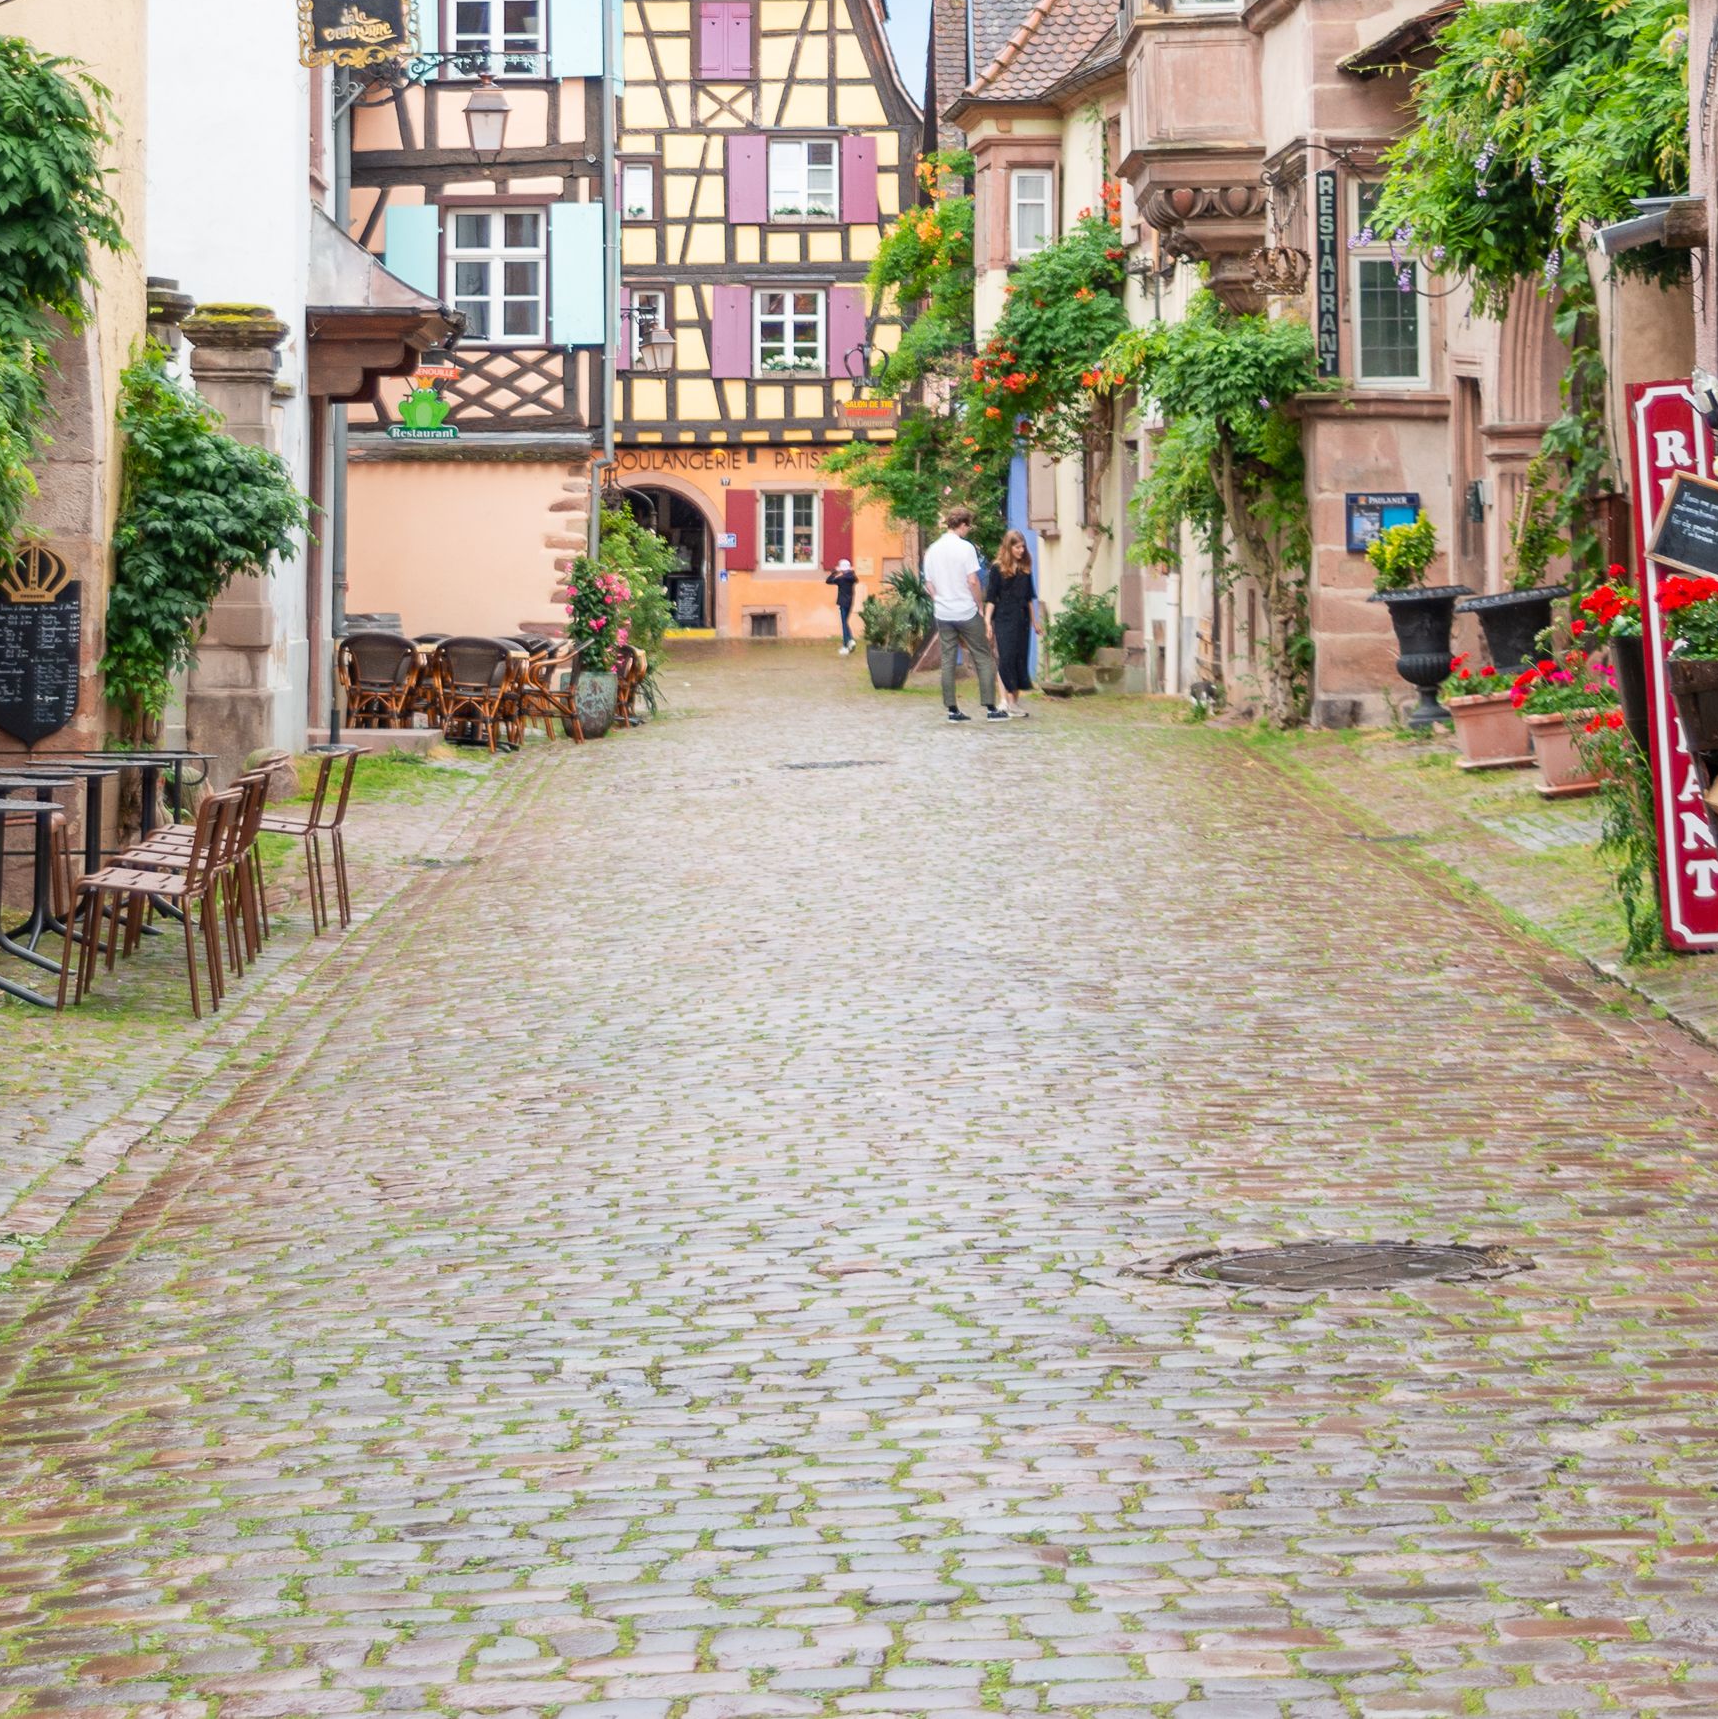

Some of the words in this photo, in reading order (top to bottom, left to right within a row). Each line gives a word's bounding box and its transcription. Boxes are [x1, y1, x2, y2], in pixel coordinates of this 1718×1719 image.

[1318, 175, 1337, 372] RESTAURANT
[844, 400, 868, 409] SALON
[392, 427, 454, 438] Restaurant
[611, 451, 742, 471] BOULANGERIE
[1369, 496, 1407, 505] PAULANER
